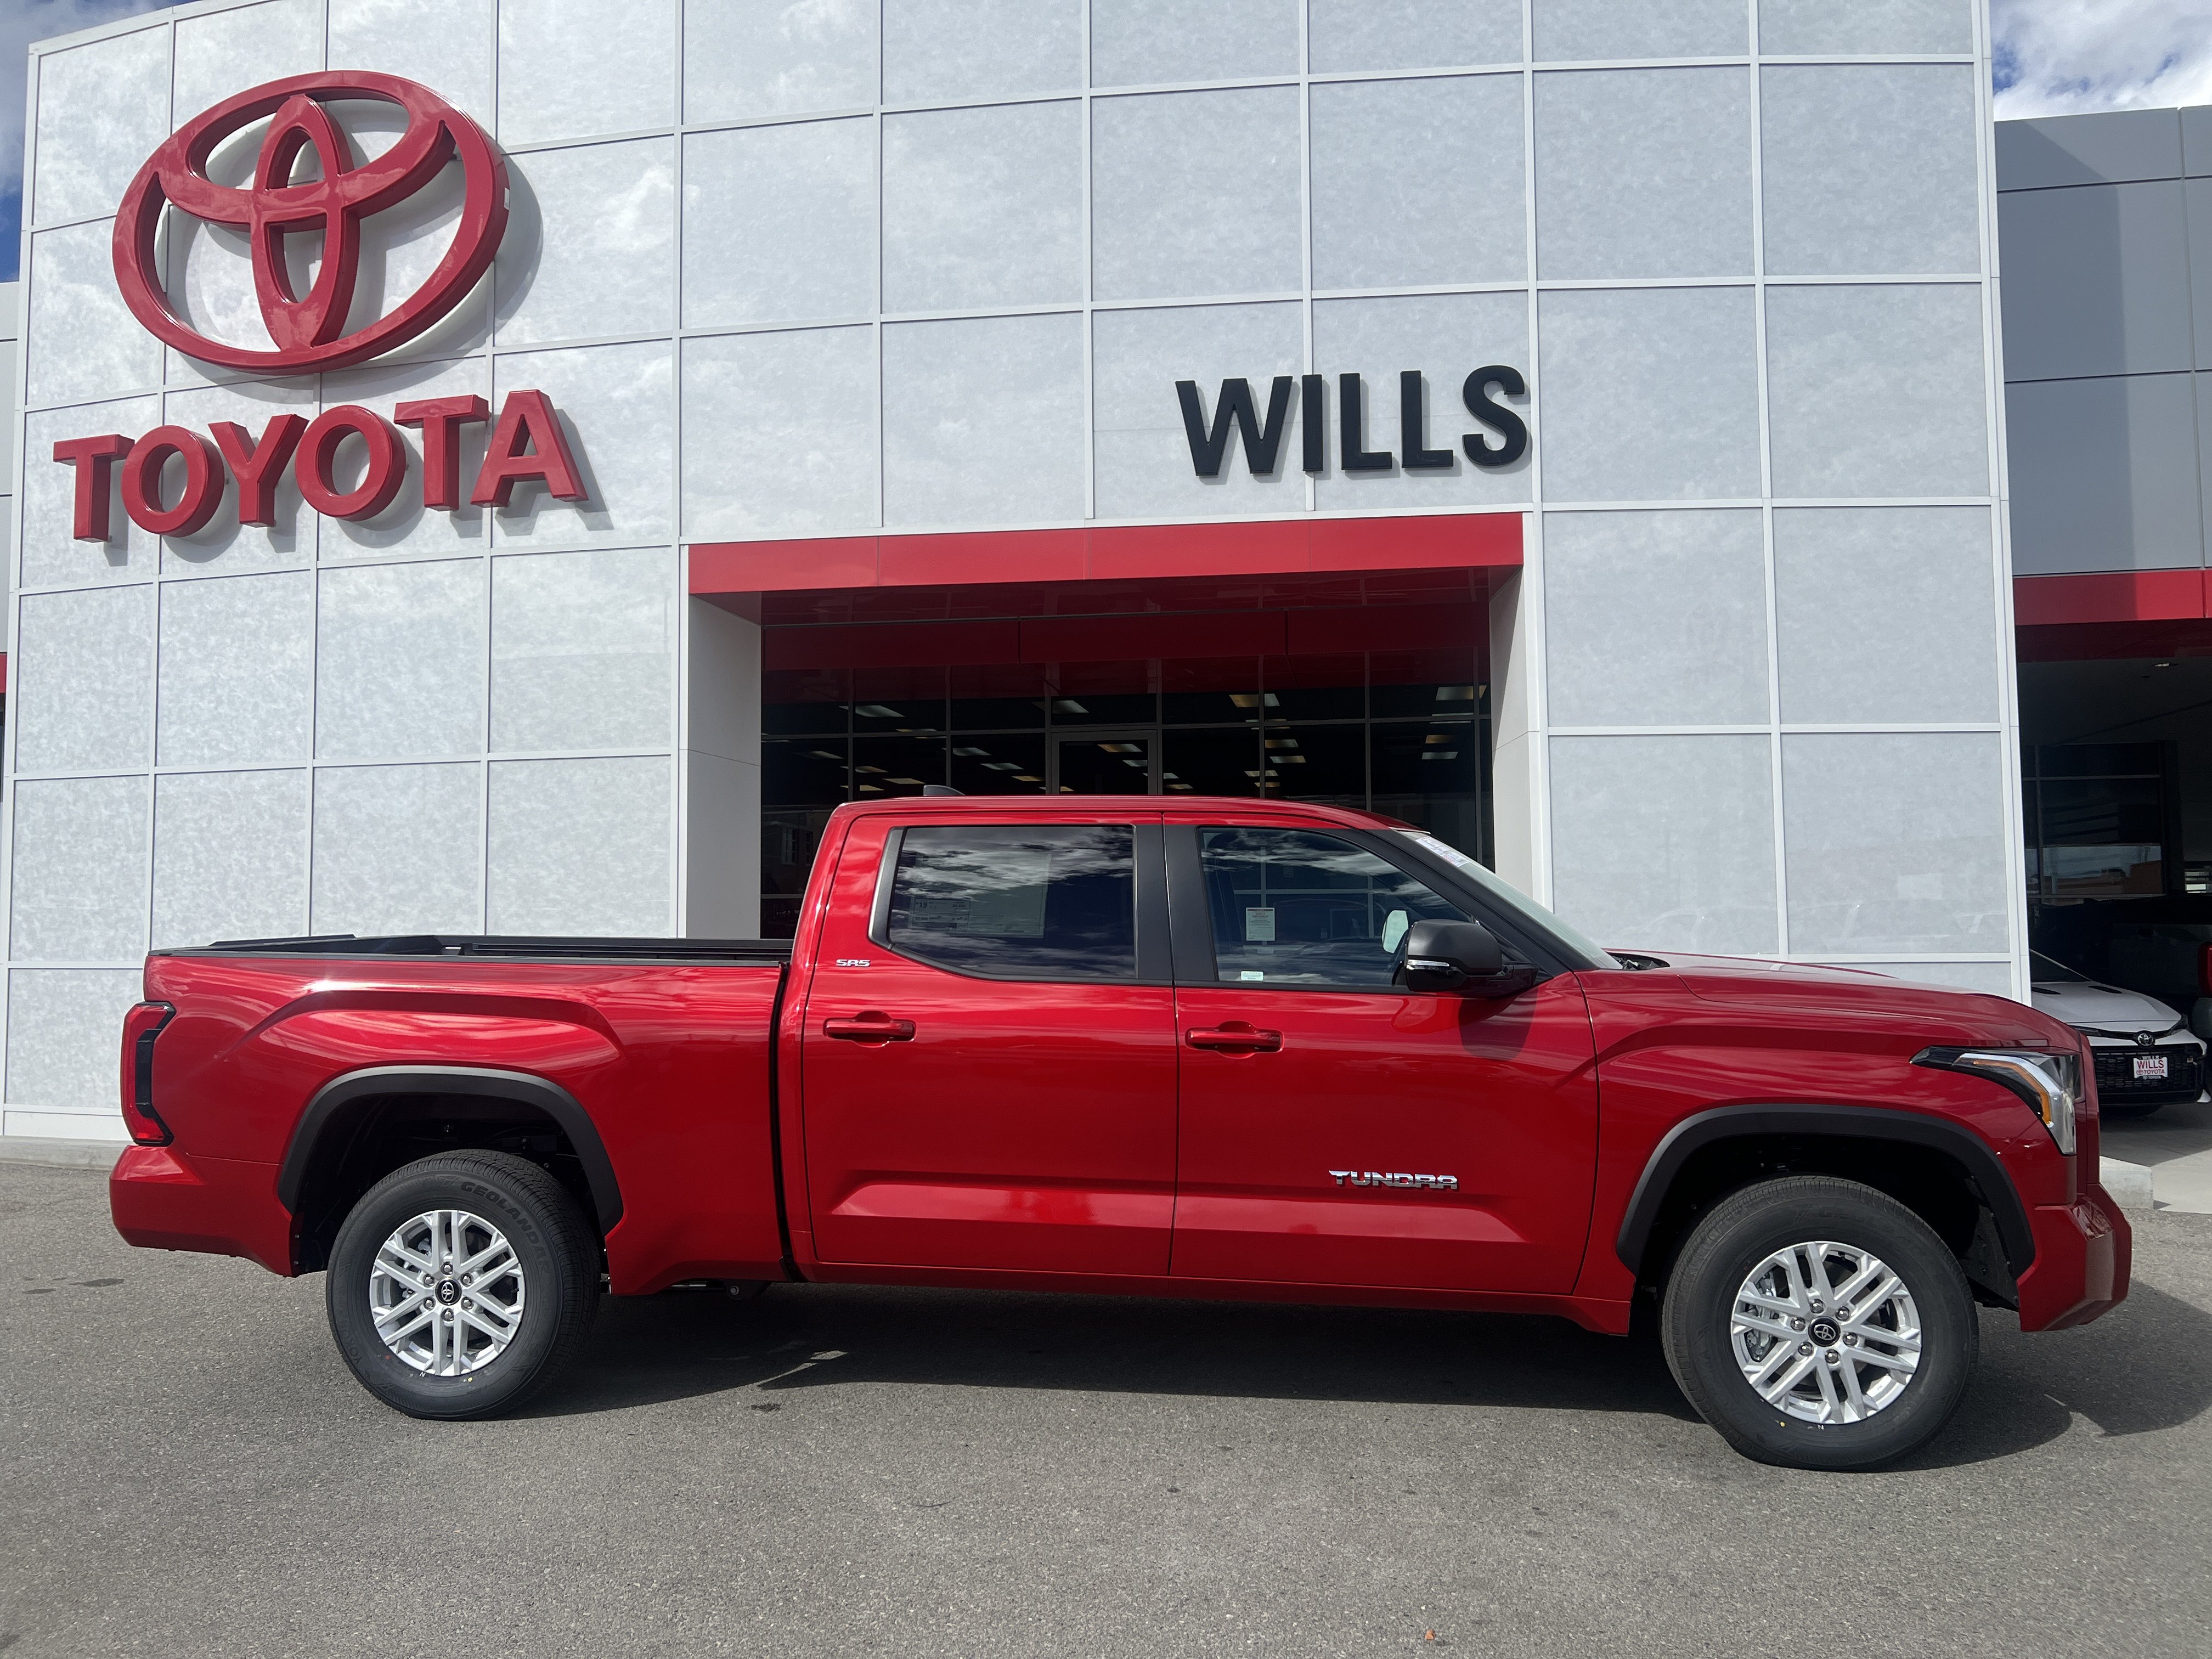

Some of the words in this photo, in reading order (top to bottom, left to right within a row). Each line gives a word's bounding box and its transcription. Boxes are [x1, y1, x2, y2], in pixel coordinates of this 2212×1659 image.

[1175, 365, 1527, 476] WILLS
[53, 389, 589, 542] TOYOTA
[836, 958, 871, 967] SR5
[2136, 1059, 2164, 1069] WILLS
[1328, 1170, 1458, 1189] TUNDRA
